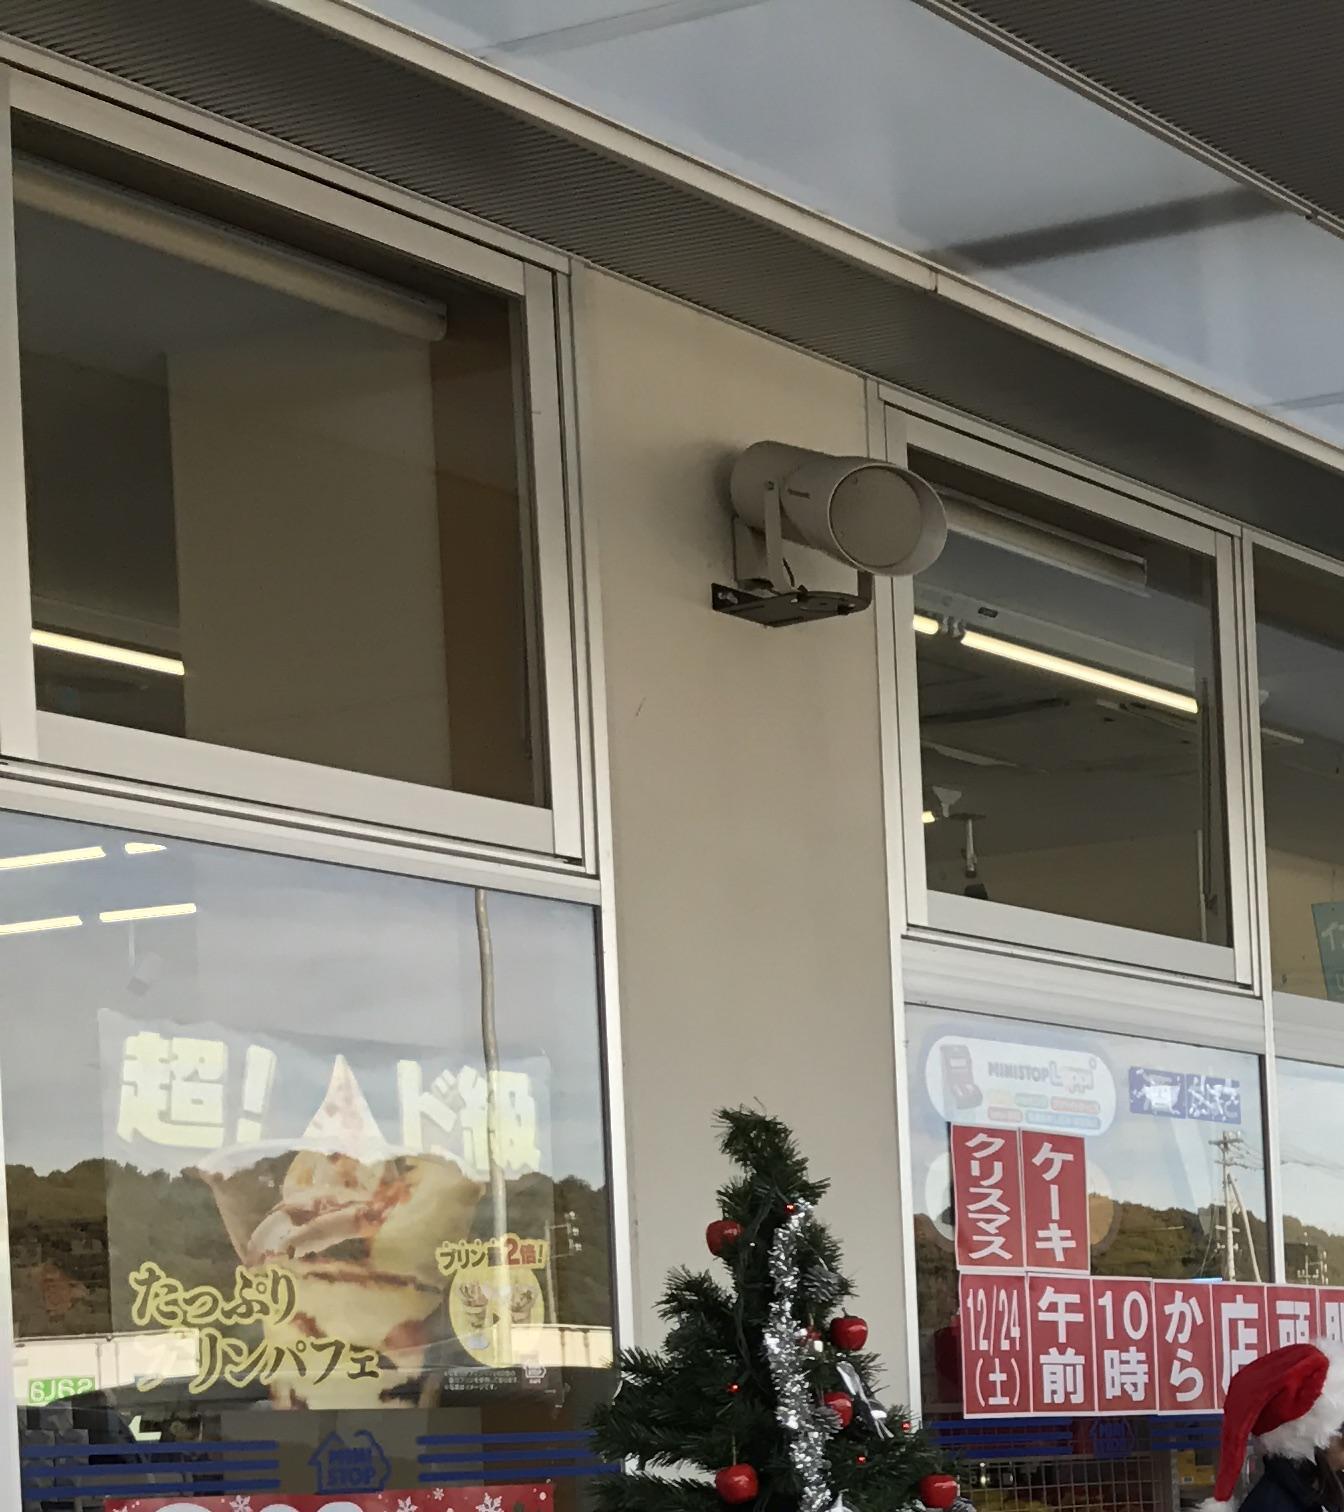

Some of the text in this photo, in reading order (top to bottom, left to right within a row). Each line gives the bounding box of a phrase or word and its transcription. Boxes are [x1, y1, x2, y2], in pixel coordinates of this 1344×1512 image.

[117, 1031, 276, 1149] 超!
[965, 1132, 1013, 1261] クリスマス
[1031, 1142, 1077, 1263] ケーキ
[130, 1261, 298, 1327] たっぷり
